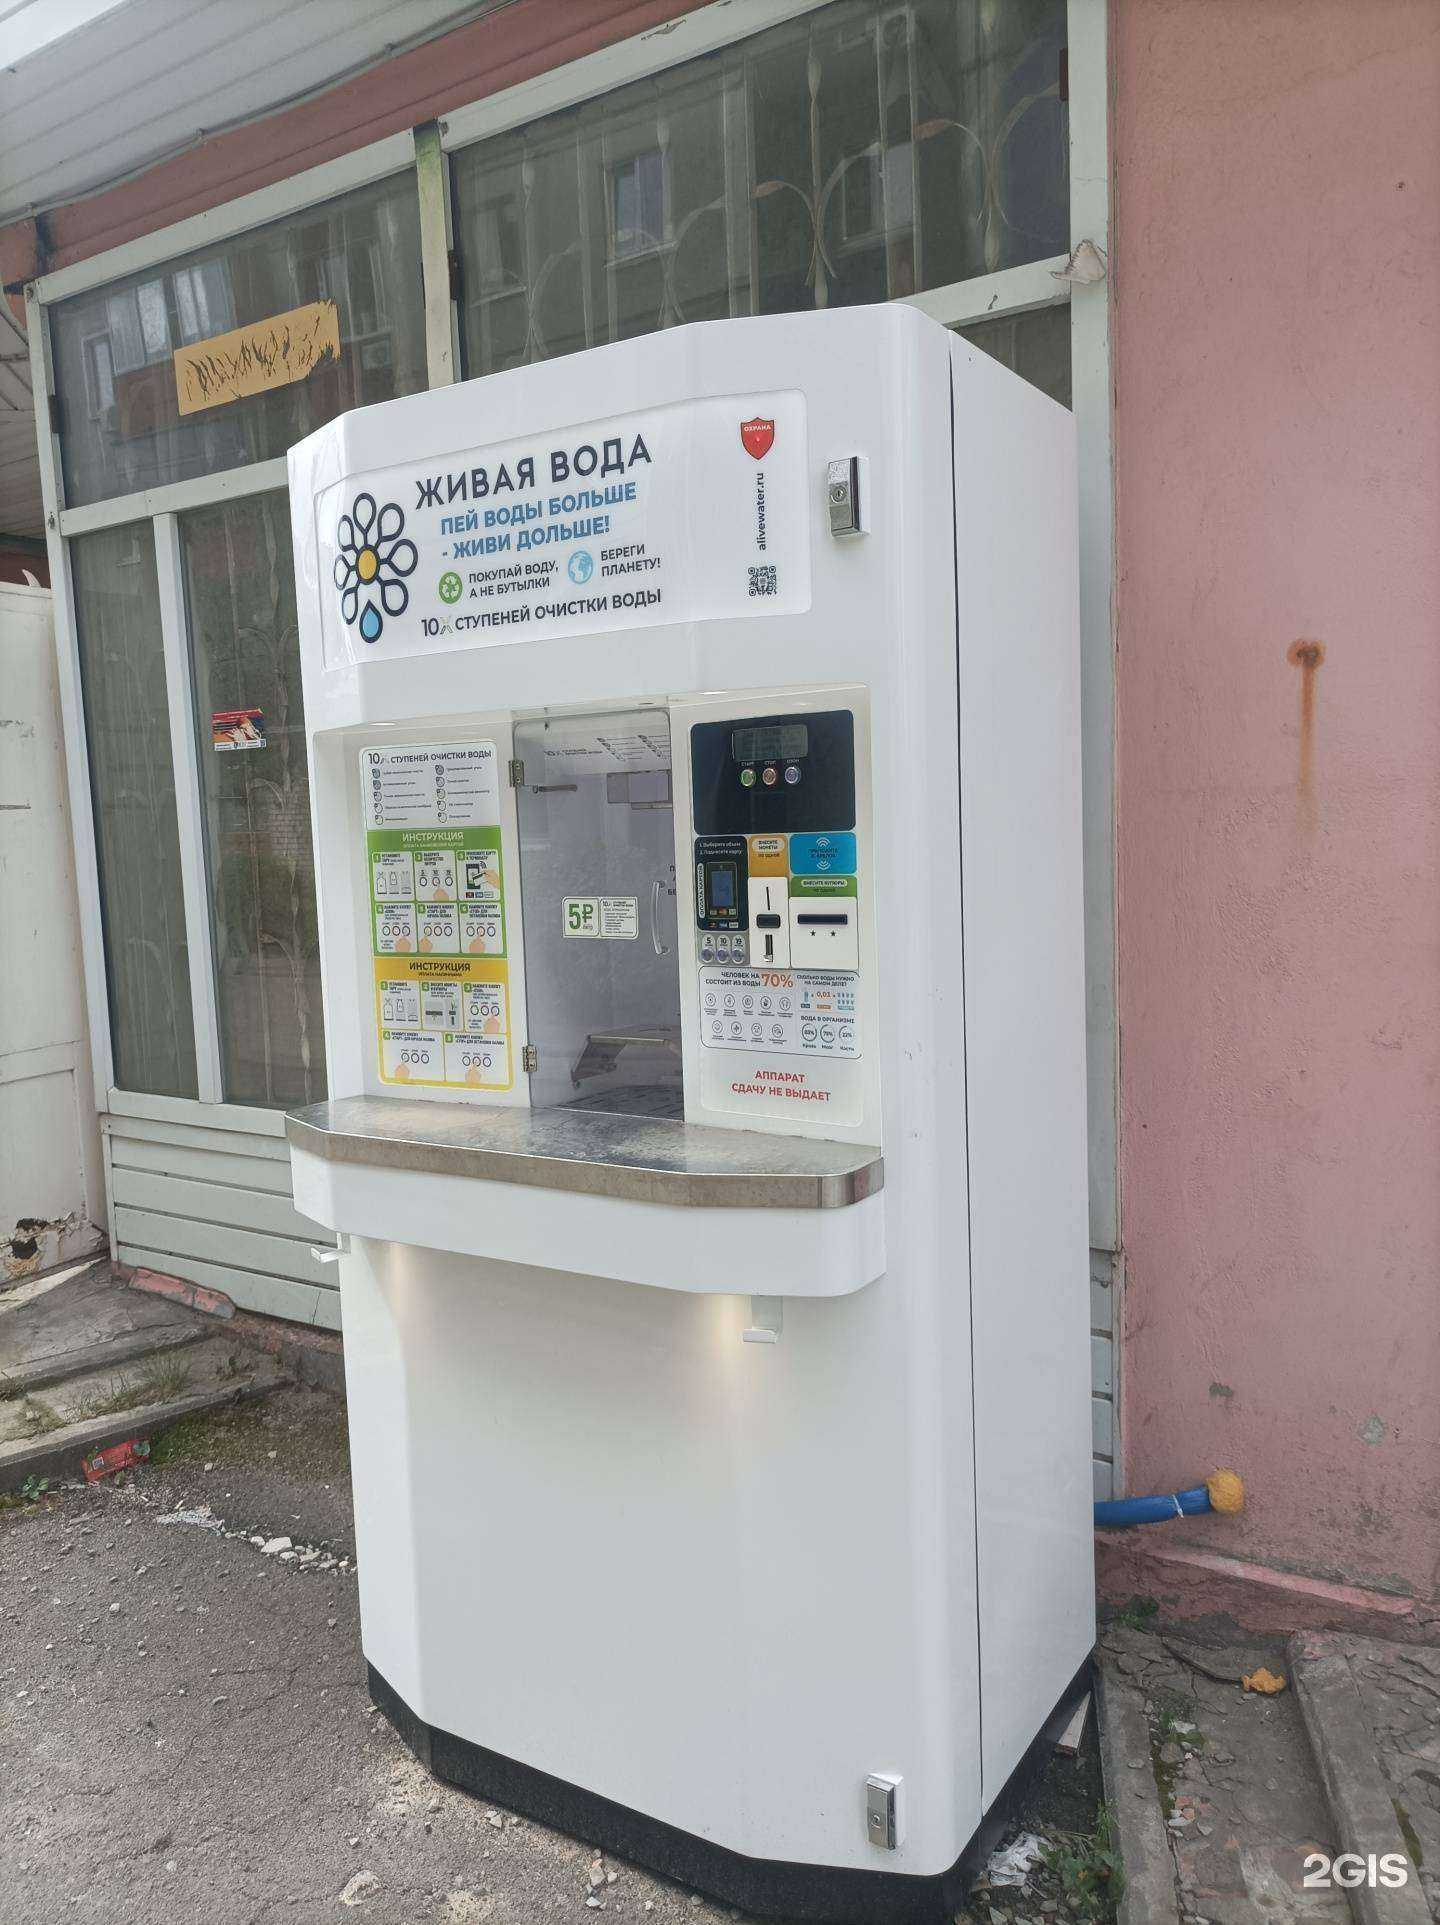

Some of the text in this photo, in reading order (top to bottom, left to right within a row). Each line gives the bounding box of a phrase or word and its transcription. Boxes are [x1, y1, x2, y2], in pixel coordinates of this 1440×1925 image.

[416, 433, 652, 510] ЖИВАЯ ВОДА
[441, 482, 636, 535] ПЕЙ ВОДЫ БОЛЬШЕ
[757, 472, 766, 551] alivewater.ru
[453, 529, 511, 560] ЖИВИ
[516, 515, 610, 551] ДОЛЬШЕ!
[601, 544, 646, 561] БЕРЕГИ
[469, 560, 559, 584] ПОКУПАЙ ВОДУ,
[602, 558, 660, 577] ПЛАНЕТУ!
[469, 577, 550, 598] А НЕ БУТЫЛКИ
[455, 606, 530, 630] СТУПЕНЕЙ
[534, 597, 608, 620] ОЧИСТКИ
[612, 589, 661, 608] ВОДЫ
[390, 754, 428, 764] СТУПЕНЕЙ
[430, 752, 466, 760] ОЧИСТКИ
[468, 750, 492, 758] ВОДЫ
[402, 832, 464, 842] ИНСТРУКЦИЯ
[410, 962, 471, 972] ИНСТРУКЦИЯ
[761, 973, 794, 988] 70%
[754, 1070, 806, 1084] АППАРАТ
[732, 1083, 831, 1102] СДАЧУ НЕ ВЫДАЕТ
